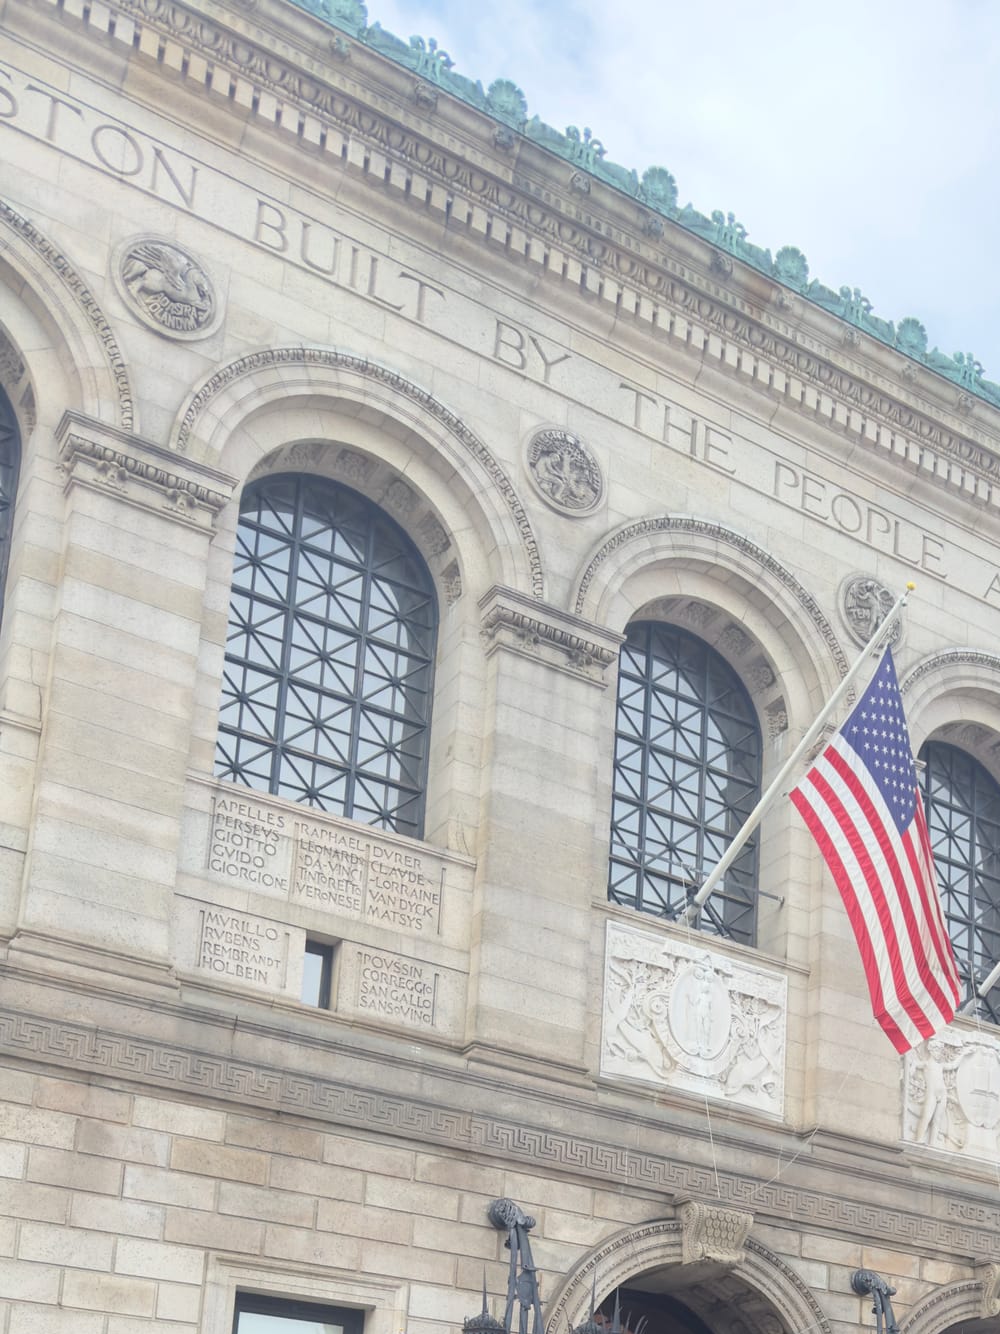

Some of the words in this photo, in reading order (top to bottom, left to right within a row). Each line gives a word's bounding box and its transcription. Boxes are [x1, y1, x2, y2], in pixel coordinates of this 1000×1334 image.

[255, 199, 446, 322] BUILT
[494, 318, 571, 384] BY
[619, 383, 736, 476] THE
[773, 460, 947, 579] PEOPLE
[217, 799, 285, 828] APELLES
[214, 828, 277, 856] GIOTTO
[301, 823, 365, 852] RAPHAEL
[373, 846, 422, 871] DVRER
[210, 858, 288, 891] GIORGIONE
[296, 881, 361, 911] VERONESE
[368, 889, 397, 906] VAN
[399, 898, 433, 918] DYCK
[206, 911, 278, 941] MVRILLO
[367, 904, 423, 930] MATSYS
[205, 926, 260, 951] RVBENS
[203, 941, 281, 969] REMBRANDT
[363, 953, 423, 978] POVSSIN
[202, 955, 268, 984] HOLBEIN
[362, 967, 433, 995] CORREGGIO
[359, 995, 431, 1023] SANSOVINO
